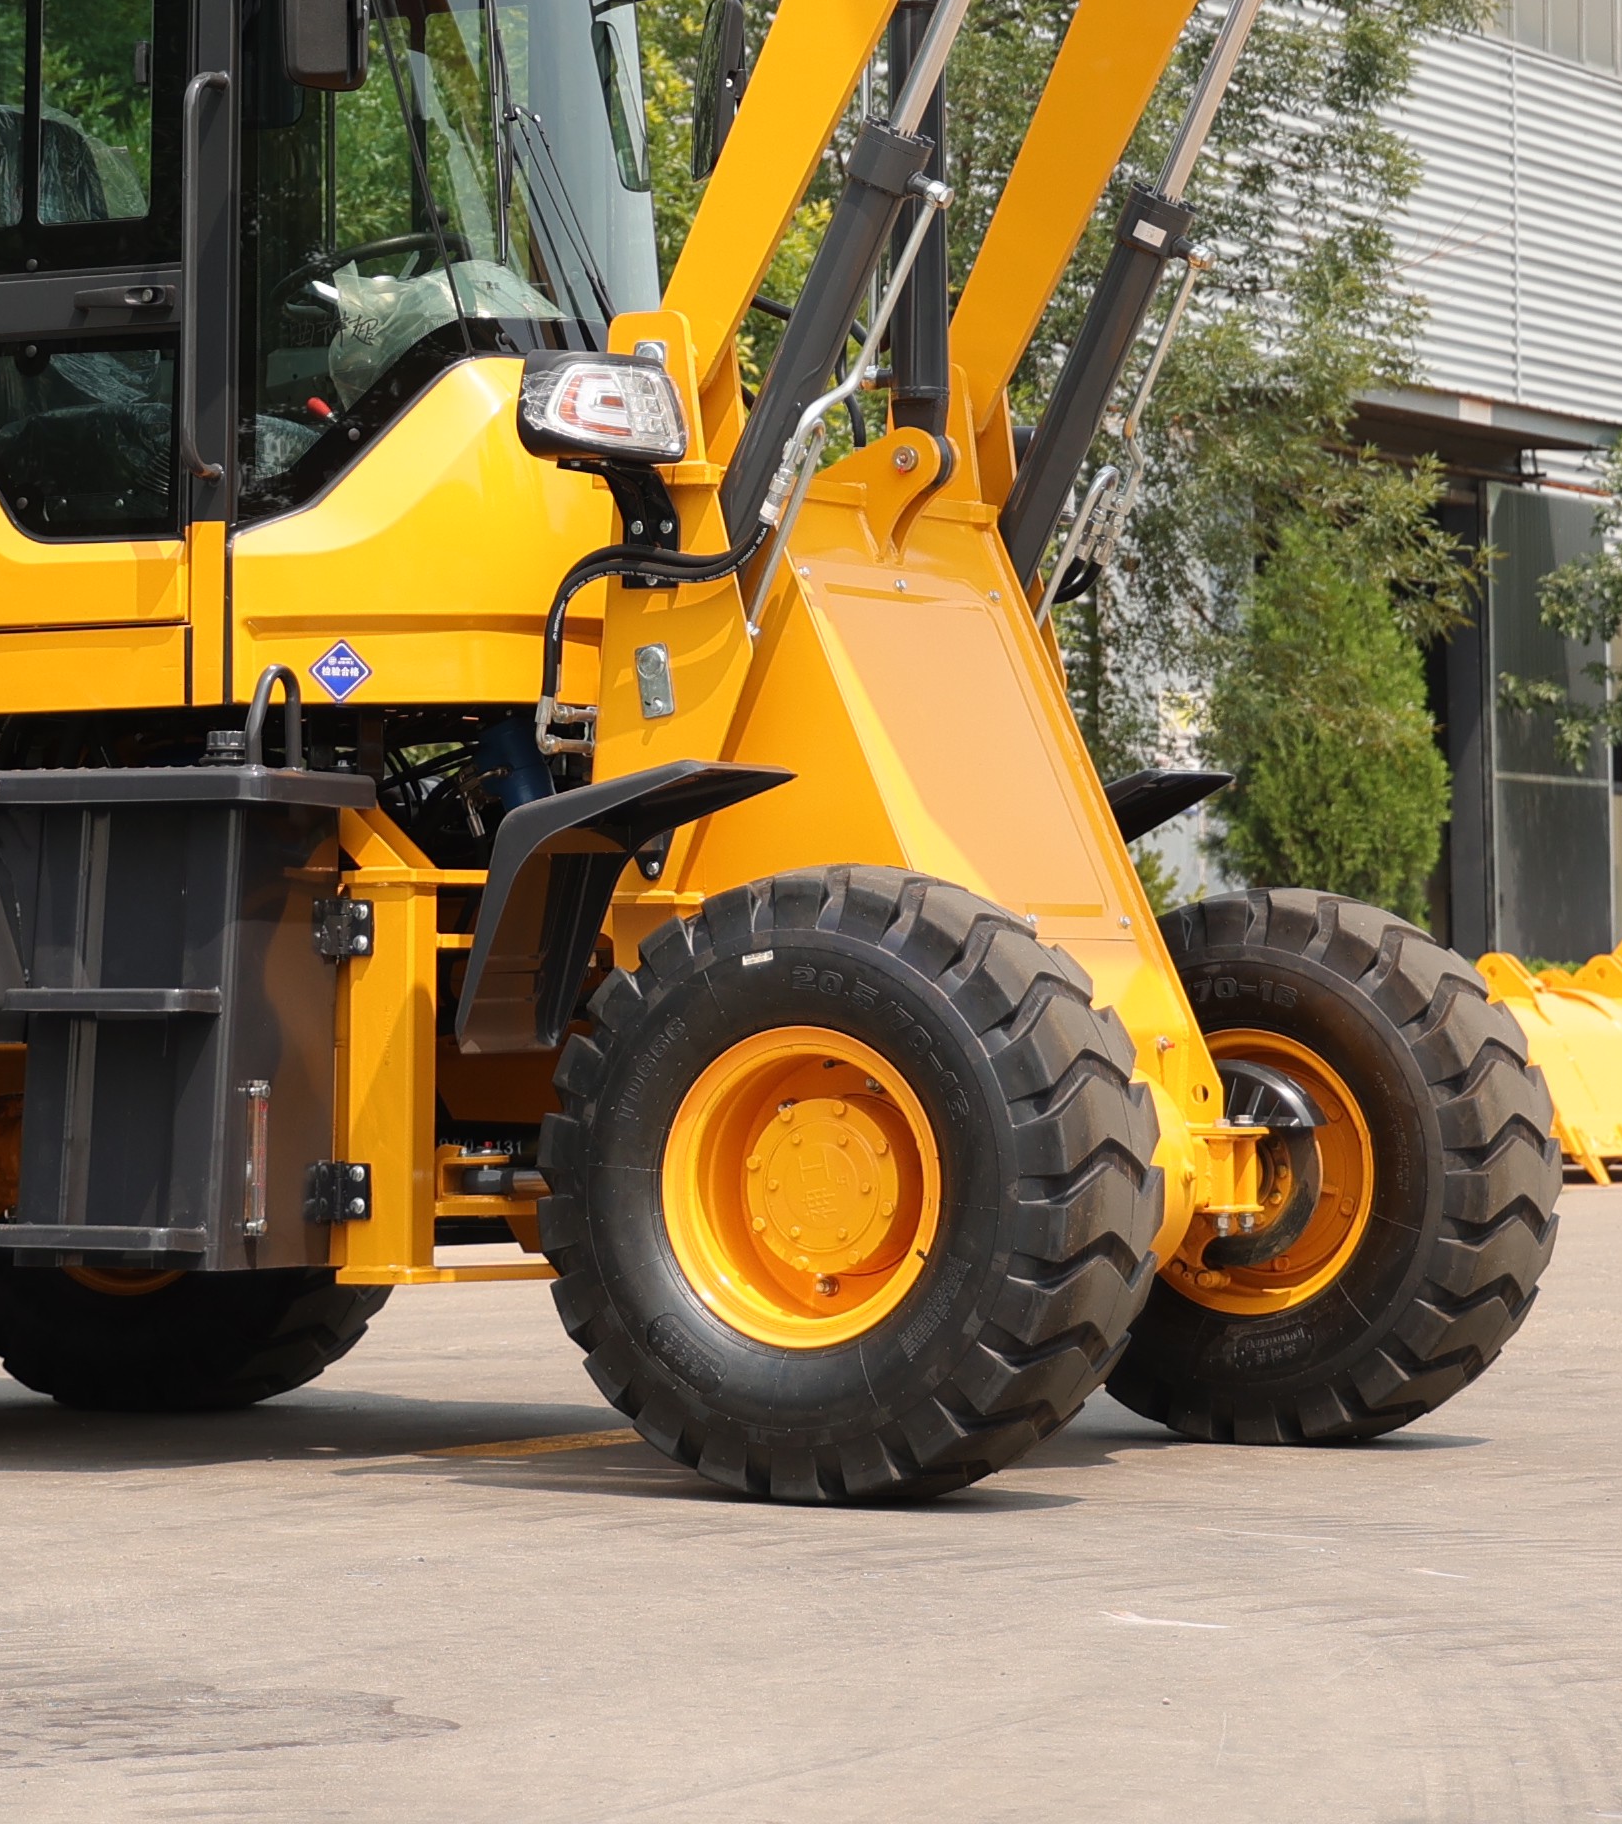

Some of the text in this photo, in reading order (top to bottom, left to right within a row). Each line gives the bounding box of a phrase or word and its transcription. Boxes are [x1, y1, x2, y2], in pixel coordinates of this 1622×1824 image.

[321, 665, 359, 677] 检验合格
[790, 965, 969, 1121] 20.5/70-16
